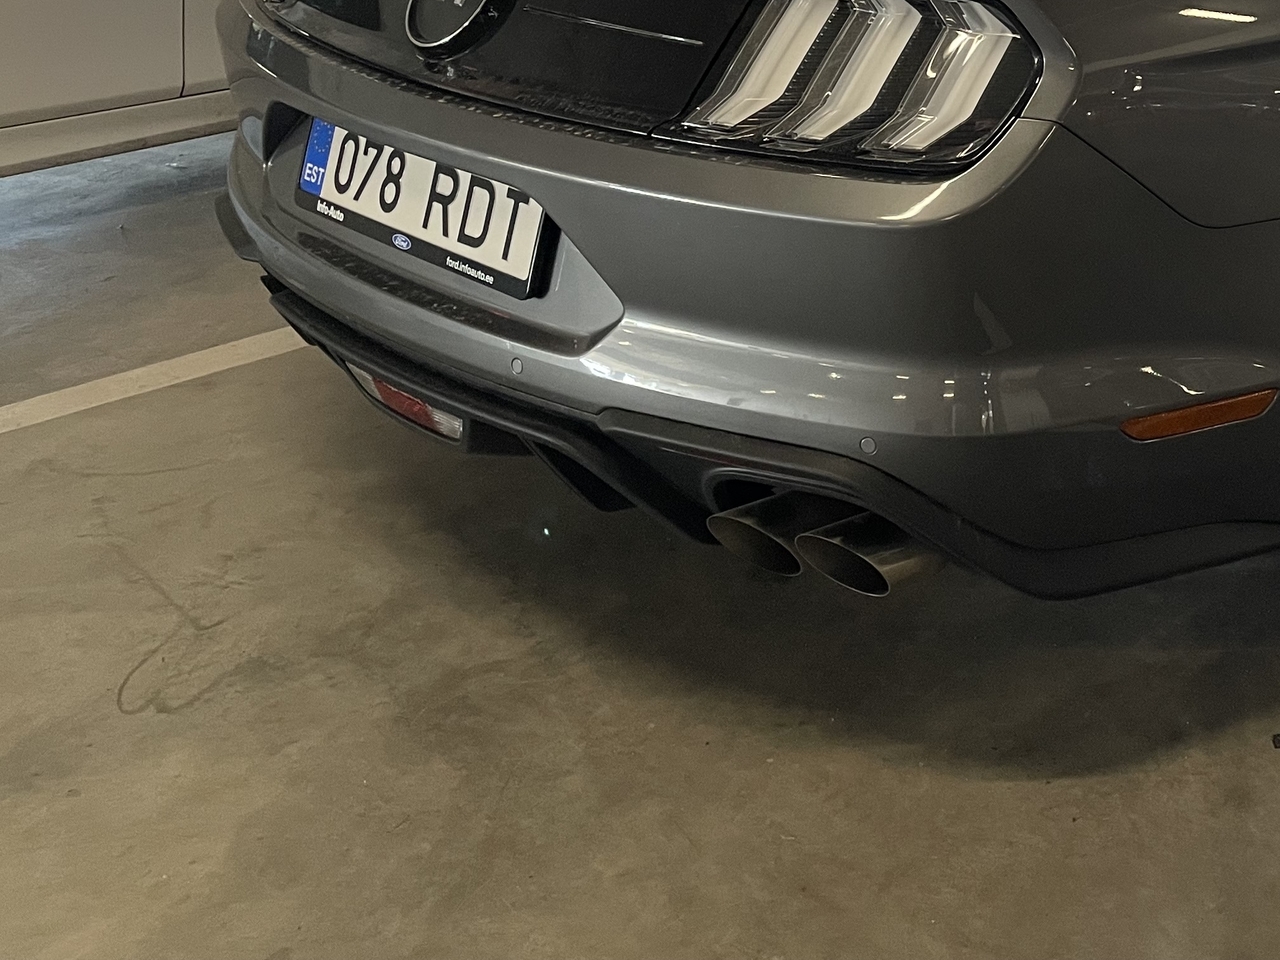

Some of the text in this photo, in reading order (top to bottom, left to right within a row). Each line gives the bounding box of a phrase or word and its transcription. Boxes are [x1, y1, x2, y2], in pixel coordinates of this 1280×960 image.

[304, 163, 325, 186] EST
[334, 131, 531, 262] 078 RDT
[316, 199, 345, 222] Info-Auto
[445, 256, 494, 285] ford.infoauto.ee
